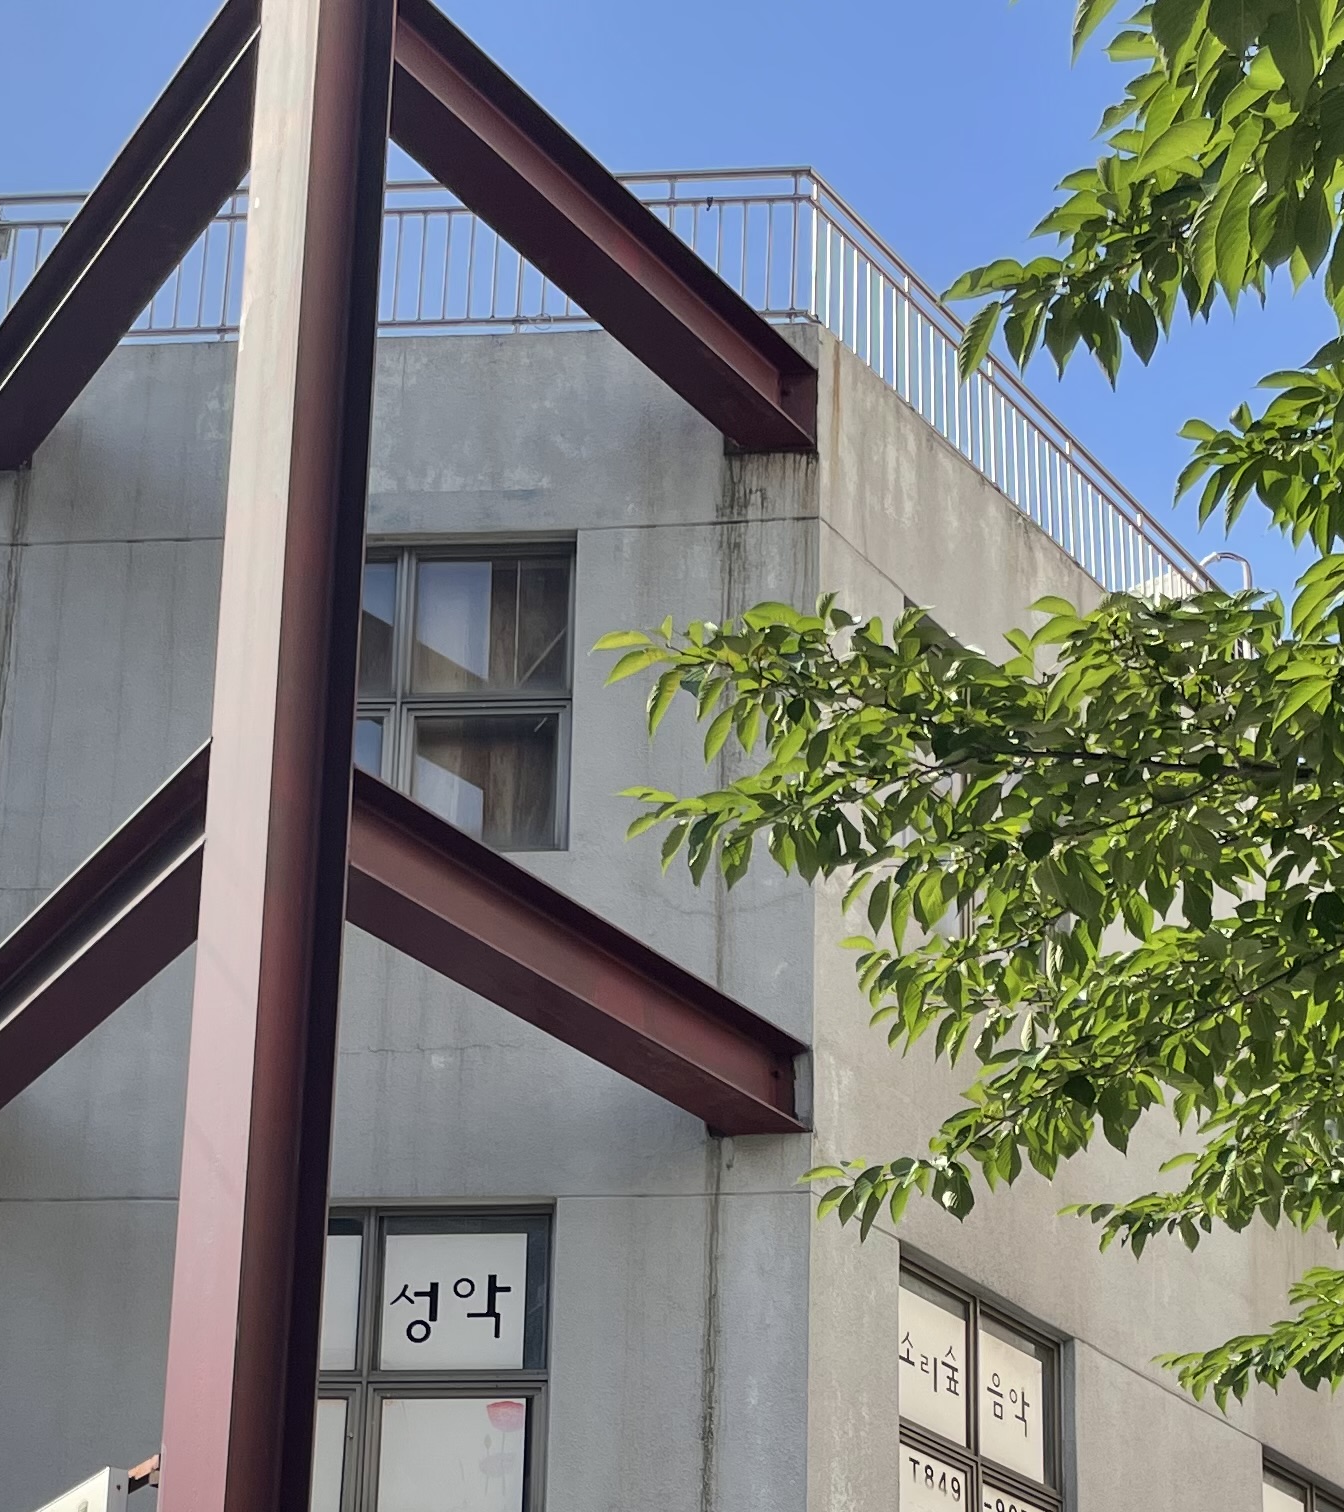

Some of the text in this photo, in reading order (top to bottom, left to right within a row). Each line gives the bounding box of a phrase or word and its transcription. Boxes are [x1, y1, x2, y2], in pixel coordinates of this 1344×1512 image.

[389, 1274, 512, 1344] 성악
[898, 1331, 1031, 1438] 소리숲 음악
